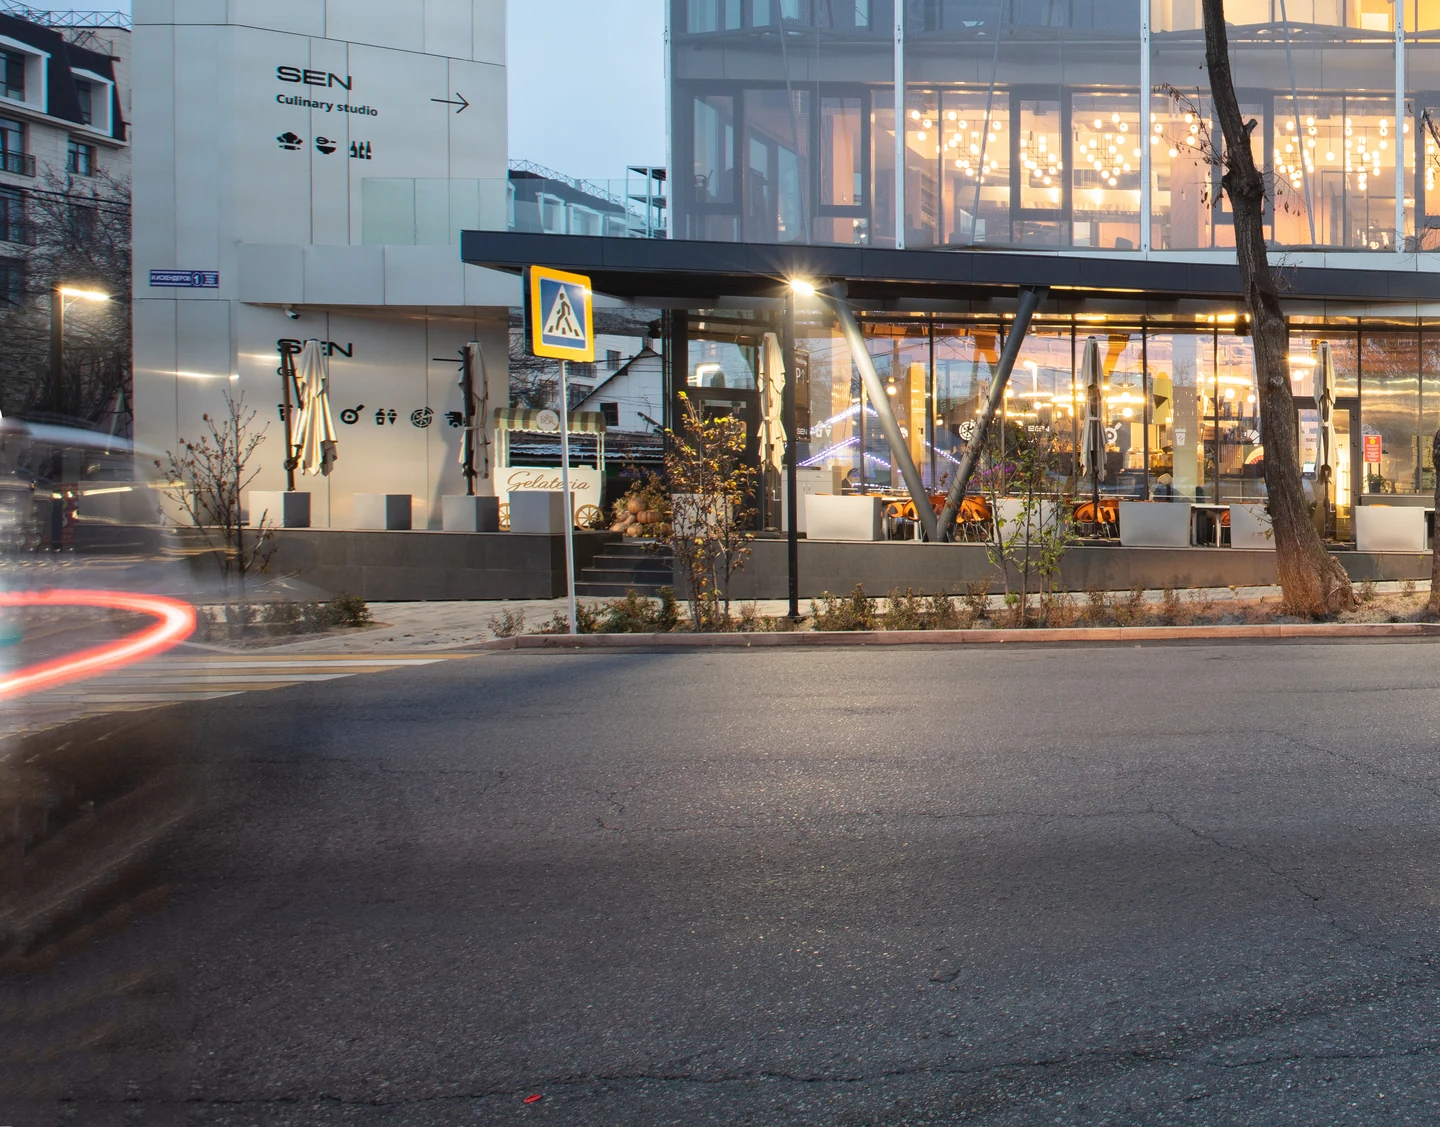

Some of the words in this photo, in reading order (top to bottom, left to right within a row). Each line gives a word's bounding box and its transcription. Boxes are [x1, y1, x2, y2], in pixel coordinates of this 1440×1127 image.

[276, 65, 353, 91] SEN
[276, 94, 334, 113] Culinary
[337, 103, 379, 117] studio
[193, 275, 199, 284] 1
[506, 470, 591, 492] Gelateia
